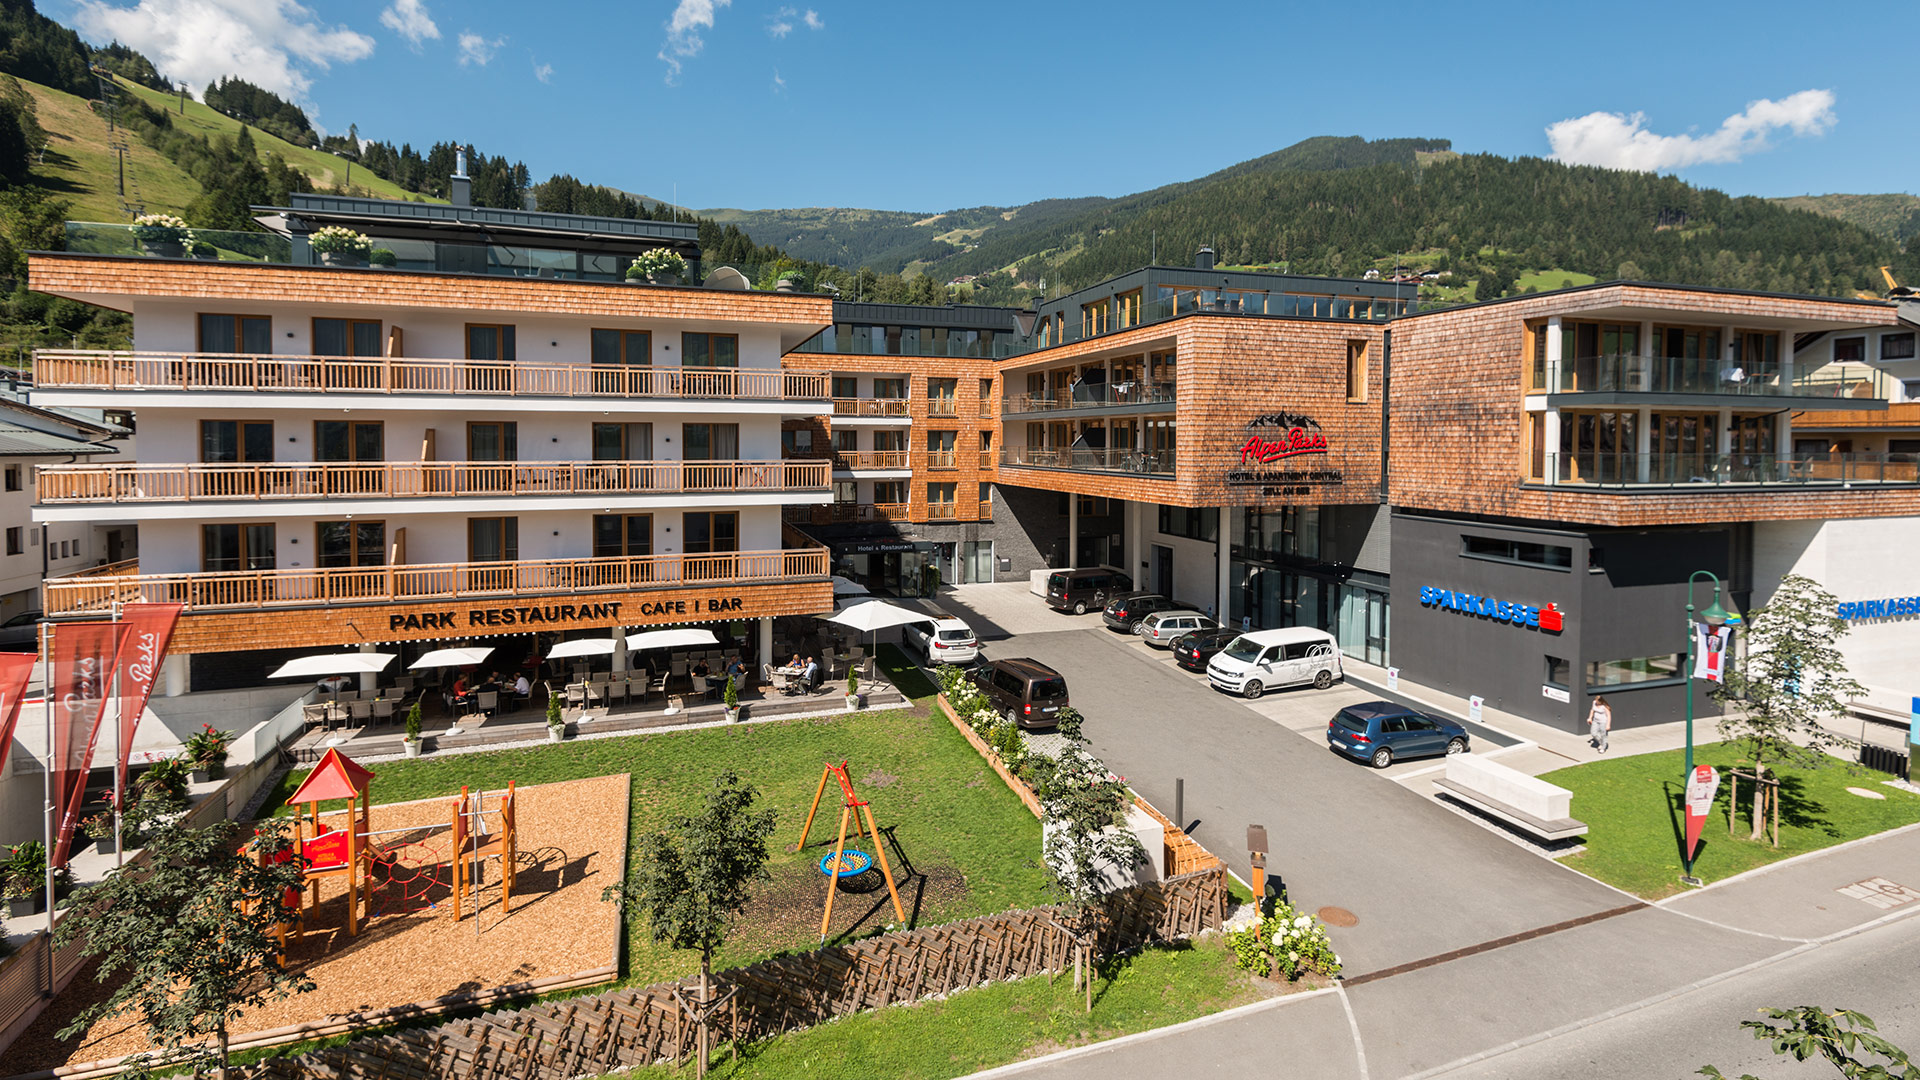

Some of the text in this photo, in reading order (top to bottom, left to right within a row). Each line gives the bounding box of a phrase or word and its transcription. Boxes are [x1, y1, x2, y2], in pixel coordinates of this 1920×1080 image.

[1229, 472, 1254, 481] HOTEL
[1263, 472, 1308, 481] APARTMENT
[1309, 471, 1342, 480] CENTRAL
[390, 602, 622, 631] PARK RESTAURANT
[641, 601, 686, 615] CAFE
[708, 598, 743, 612] BAR
[1419, 585, 1539, 628] SPARKASSE
